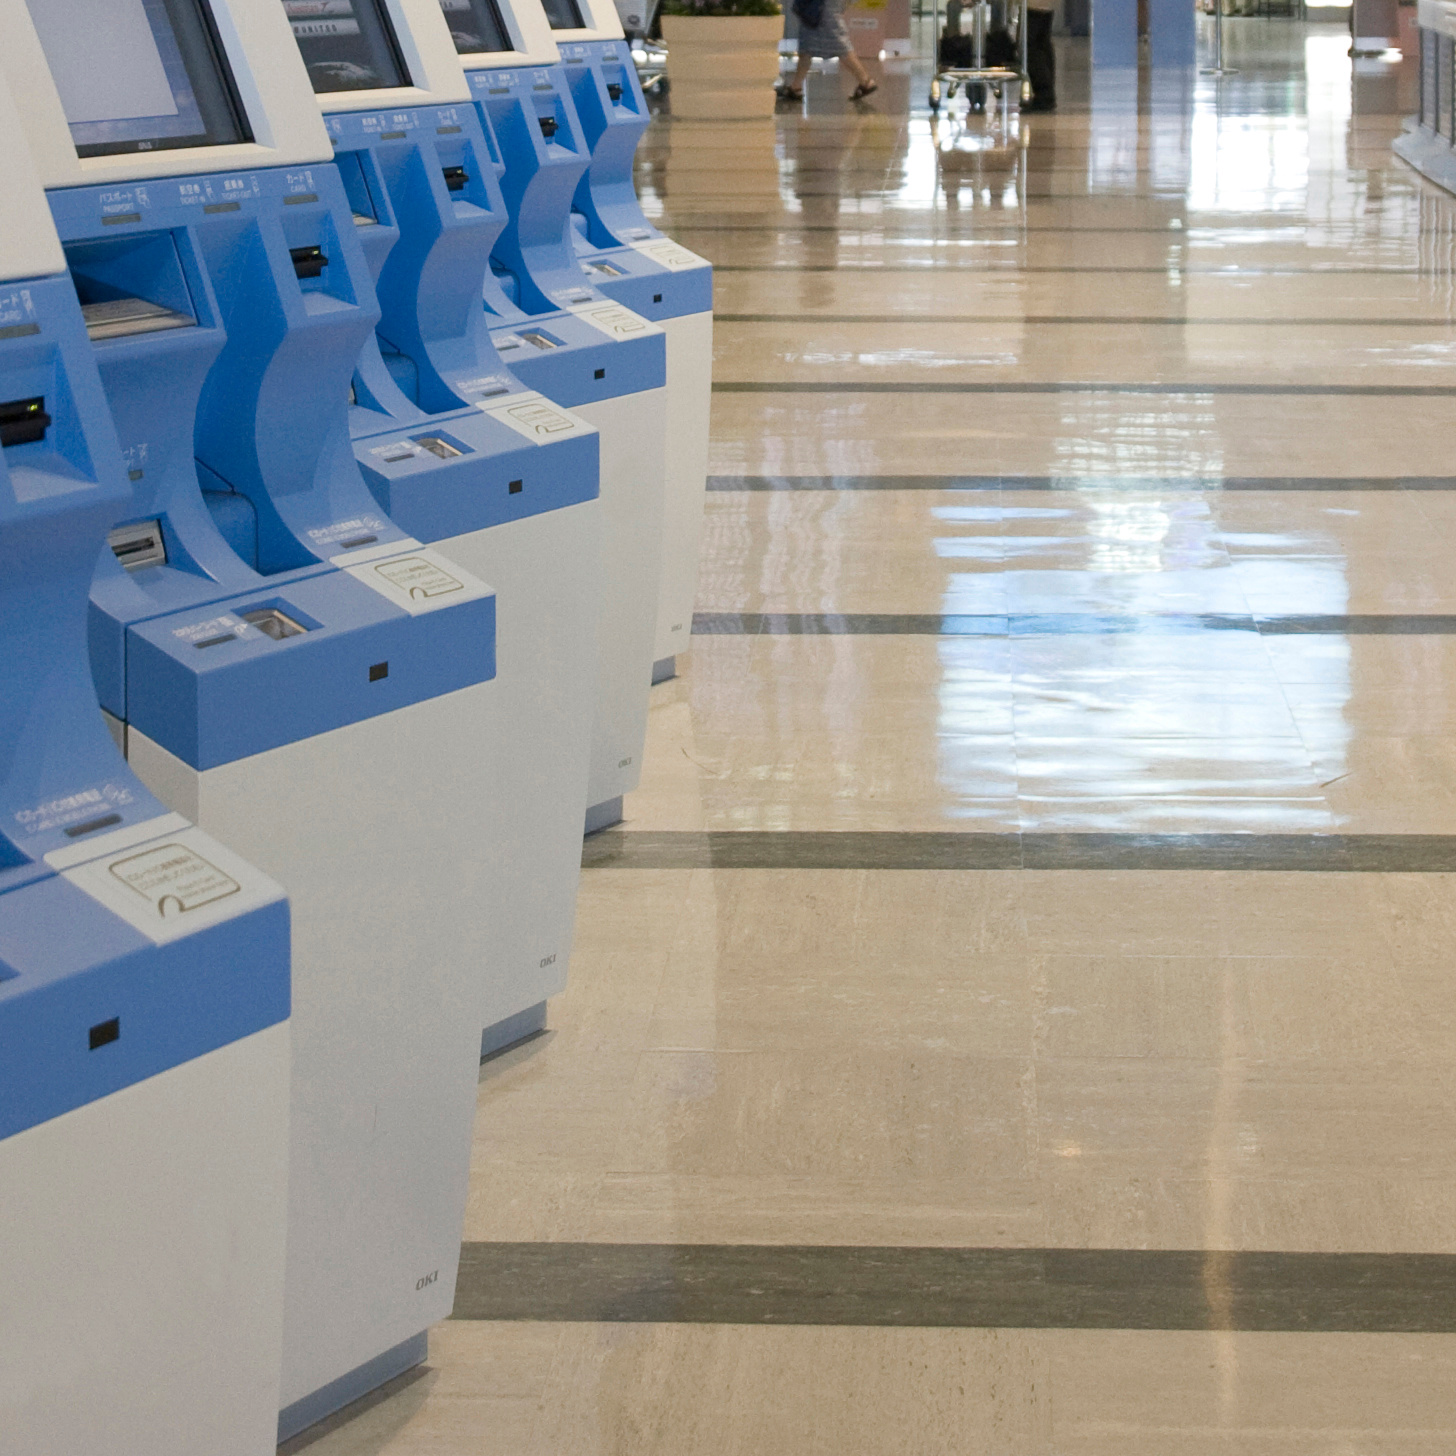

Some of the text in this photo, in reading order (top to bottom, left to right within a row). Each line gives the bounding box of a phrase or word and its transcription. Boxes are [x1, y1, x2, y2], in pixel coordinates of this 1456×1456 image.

[302, 24, 337, 34] UNITED
[540, 953, 557, 969] OKI
[415, 1270, 439, 1291] OKI
